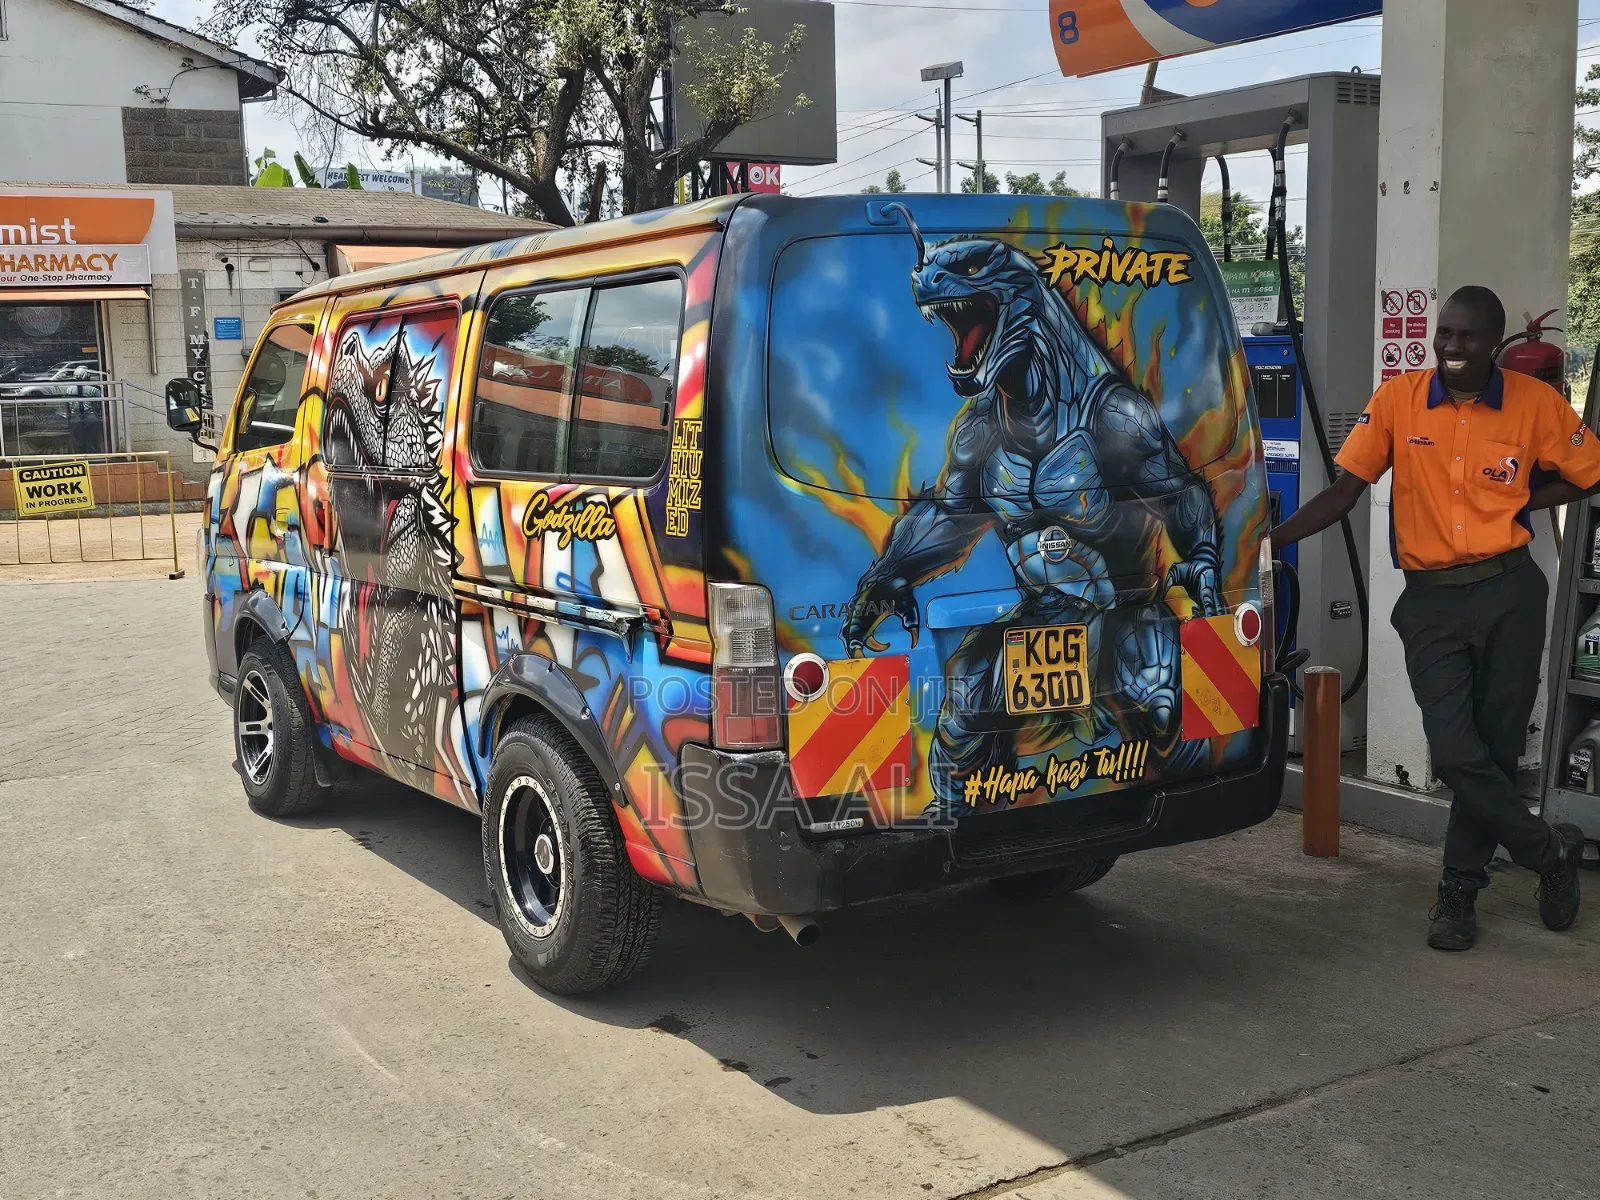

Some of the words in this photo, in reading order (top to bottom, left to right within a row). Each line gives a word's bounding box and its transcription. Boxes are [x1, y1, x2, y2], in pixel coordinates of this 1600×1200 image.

[1057, 10, 1079, 45] 8
[371, 174, 410, 185] WELCOME
[0, 217, 77, 245] mist
[0, 253, 118, 273] HARMACY
[1041, 237, 1192, 289] PRIVATE
[20, 274, 63, 282] One-Stop
[66, 273, 113, 283] Pharmacy
[671, 419, 703, 450] LIT
[22, 466, 83, 481] CAUTION
[669, 448, 704, 480] HIU
[1482, 467, 1507, 479] OLA
[26, 481, 83, 499] WORK
[38, 496, 88, 508] PROGRESS
[666, 477, 702, 510] MIZ
[523, 492, 616, 549] Godzilla
[665, 506, 689, 537] ED
[1042, 541, 1071, 550] NISSAN
[789, 600, 895, 621] CARAVAN
[1025, 628, 1083, 667] KCG
[1012, 669, 1084, 710] 630D
[964, 764, 1040, 807] #Hapa
